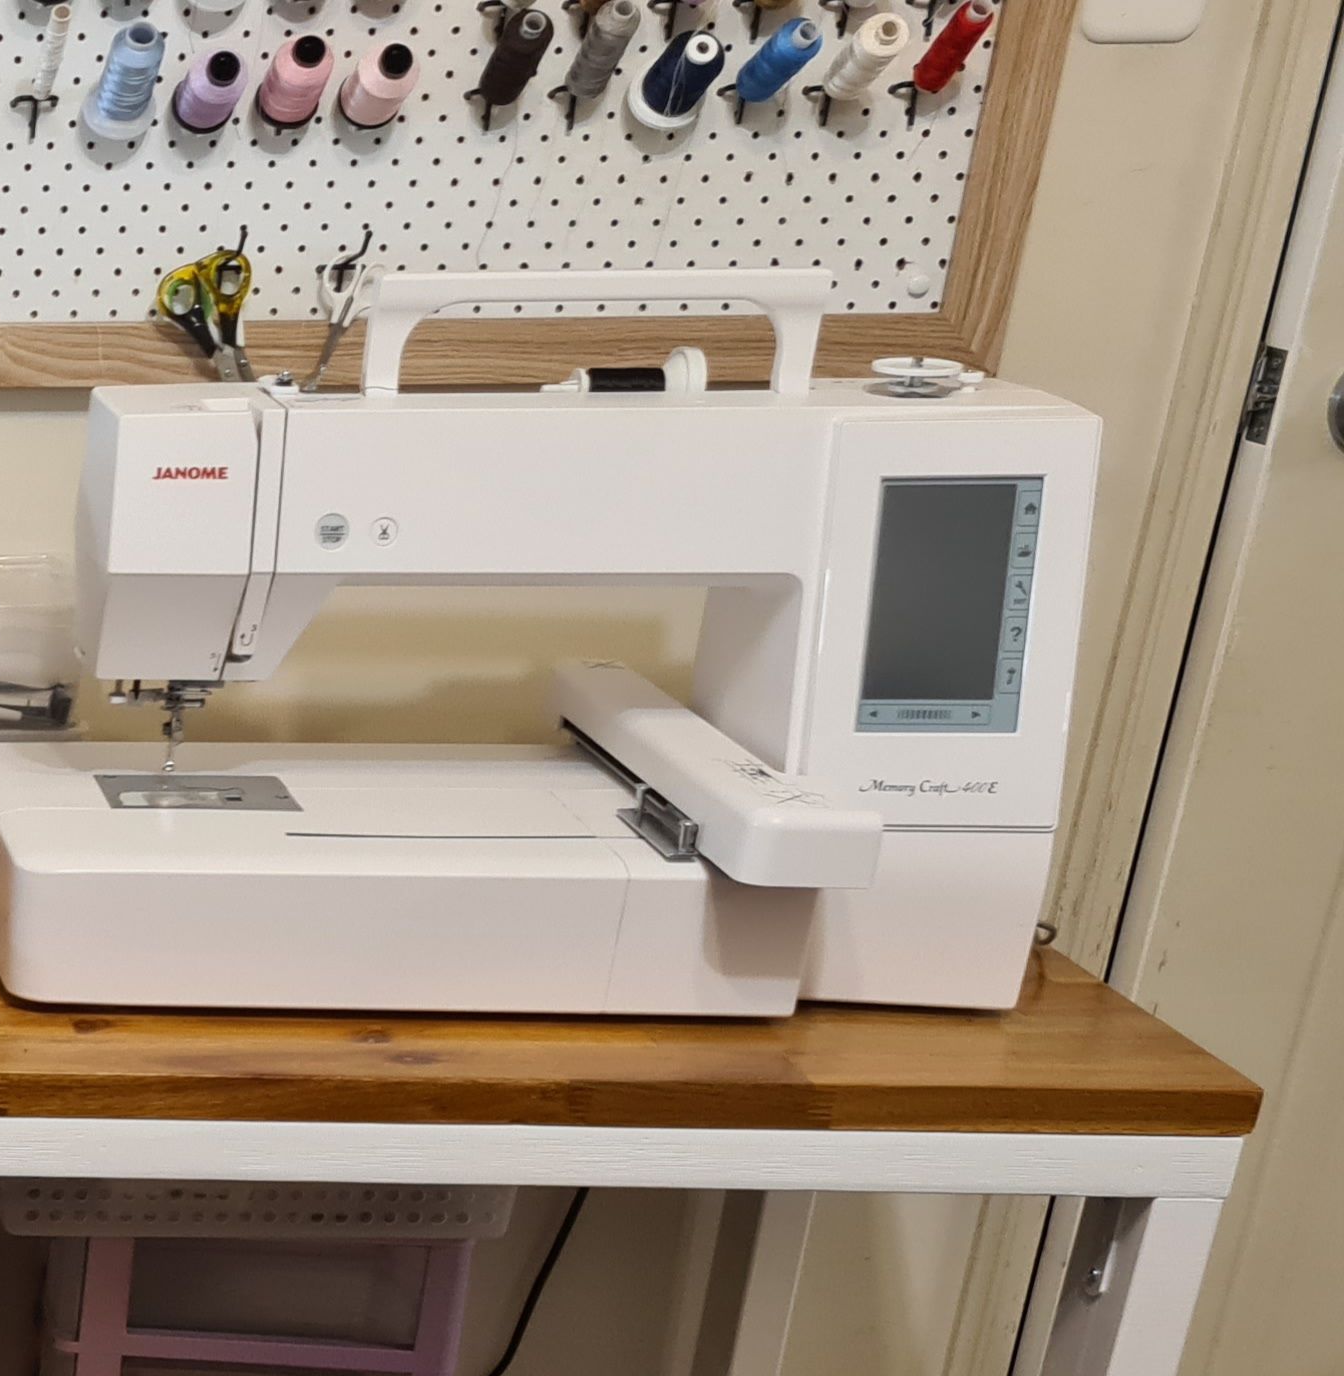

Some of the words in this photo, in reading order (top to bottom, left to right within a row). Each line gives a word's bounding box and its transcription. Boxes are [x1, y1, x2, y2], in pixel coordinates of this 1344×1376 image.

[152, 466, 229, 480] JANOME
[858, 779, 916, 797] Memory
[919, 780, 962, 796] Craft
